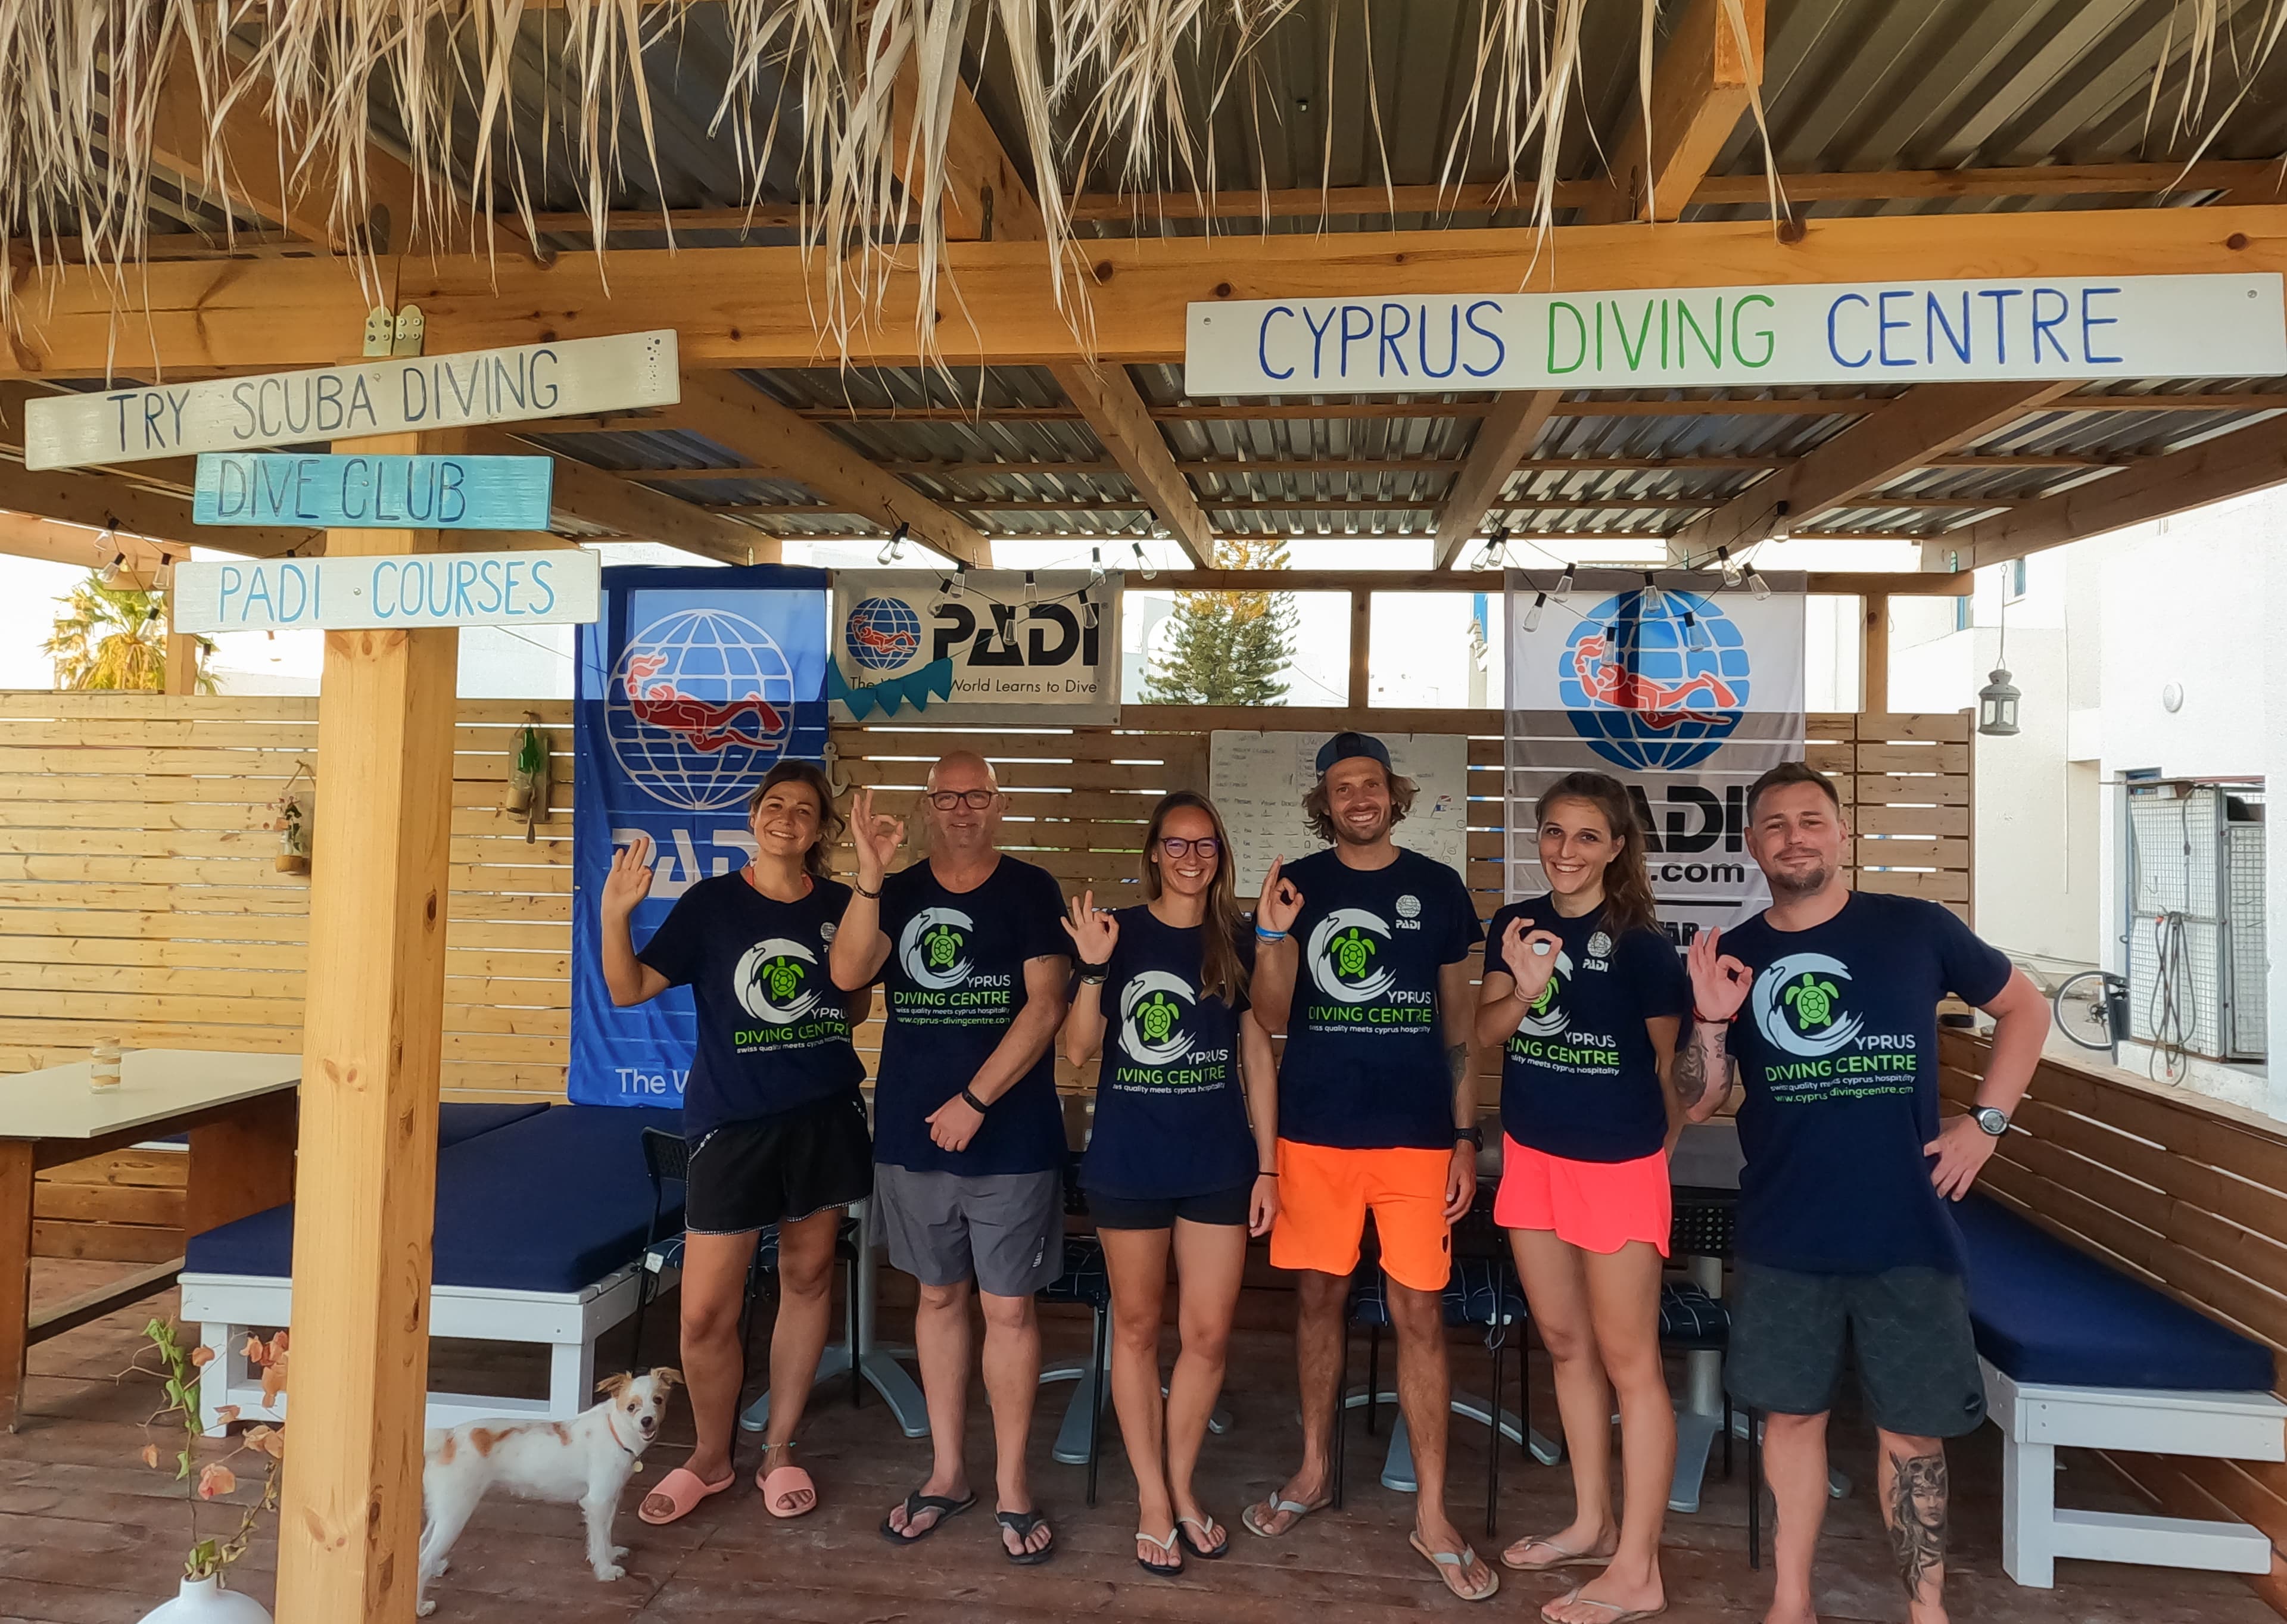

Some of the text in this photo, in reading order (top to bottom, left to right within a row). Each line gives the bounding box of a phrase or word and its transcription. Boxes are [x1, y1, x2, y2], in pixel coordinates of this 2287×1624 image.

[1258, 287, 2123, 381] CYPRUS DIVING CENTRE
[107, 349, 559, 453] TRY SCUBA DIVING
[217, 457, 466, 522] DIVE CLUB
[219, 560, 554, 623] PADI COURSES
[934, 603, 1099, 666] PADI
[996, 680, 1040, 692] Learns
[1047, 681, 1059, 692] to
[1065, 680, 1096, 693] Dive
[1396, 919, 1420, 930] PADI
[1582, 958, 1609, 972] PADI
[894, 992, 1010, 1005] DIVING CENTRE
[1309, 1006, 1431, 1023] DIVING CENTRE
[735, 1028, 793, 1045] DIVING
[1547, 1045, 1620, 1065] CENTRE
[1116, 1065, 1225, 1084] IVING CENTRE
[1527, 1058, 1551, 1068] meets
[1552, 1064, 1575, 1073] cyprus
[1577, 1067, 1619, 1076] hospitality
[1765, 1055, 1917, 1081] DIVING CENTRE
[615, 1068, 666, 1094] The
[1124, 1085, 1148, 1094] quality
[1789, 1082, 1818, 1092] quality
[1843, 1077, 1874, 1086] cyprus
